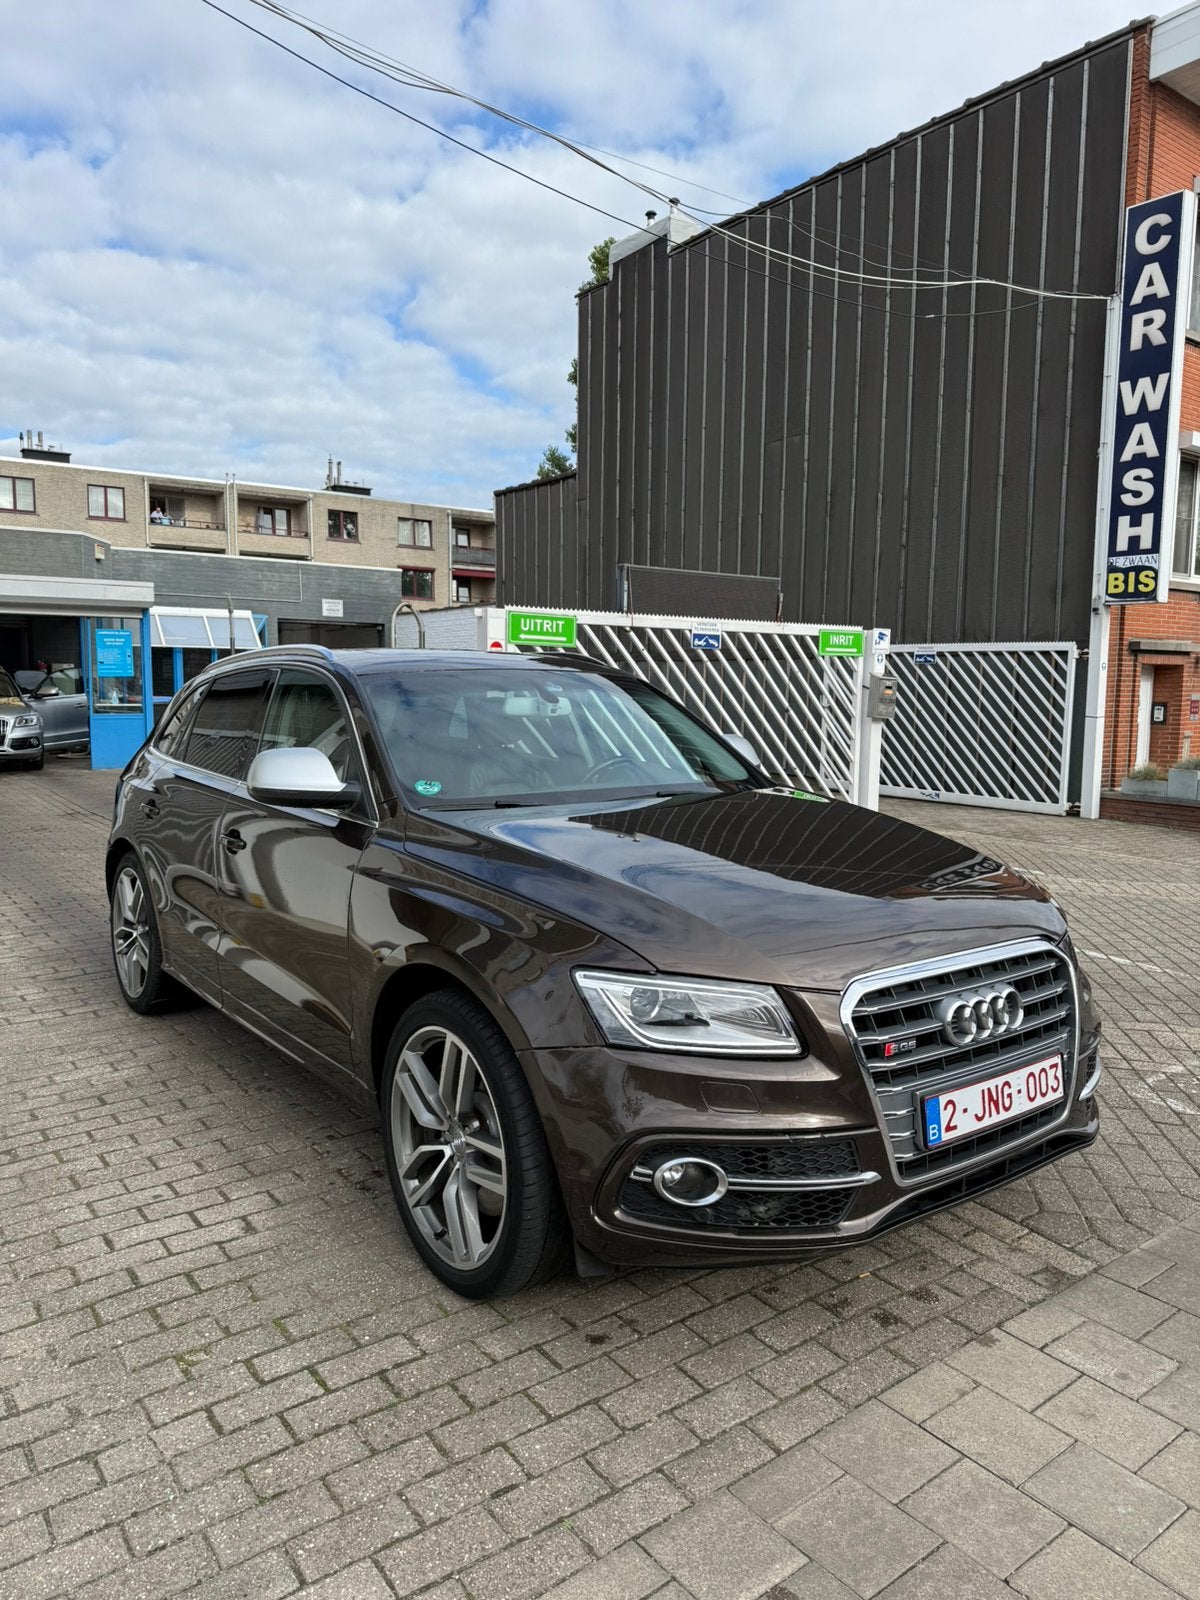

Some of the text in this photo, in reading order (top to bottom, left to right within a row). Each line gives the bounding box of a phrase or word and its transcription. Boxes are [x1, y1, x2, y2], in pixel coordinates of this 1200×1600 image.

[1115, 213, 1173, 552] CAR WASH
[1122, 554, 1158, 567] ZWAAN
[1107, 570, 1156, 594] BIS
[521, 618, 565, 633] UITRIT
[830, 634, 854, 646] INRIT
[929, 1123, 939, 1140] B
